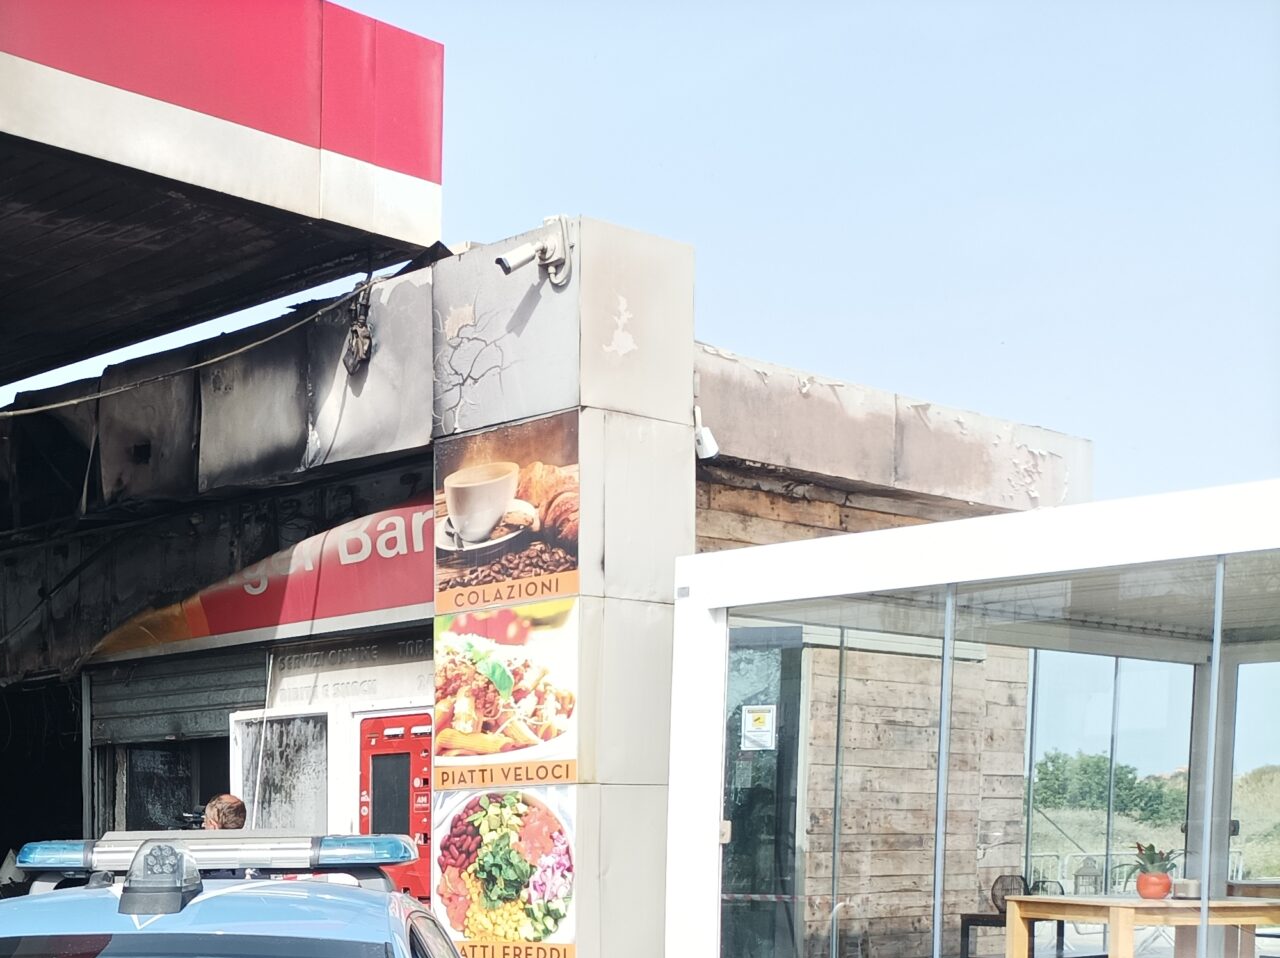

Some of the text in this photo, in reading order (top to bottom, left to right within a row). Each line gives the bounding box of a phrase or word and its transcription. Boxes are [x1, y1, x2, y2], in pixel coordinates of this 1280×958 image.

[338, 508, 434, 565] Bar
[454, 578, 561, 608] COLAZIONI
[278, 652, 325, 671] SERVIZI
[440, 760, 570, 788] PIATTI VELOCI
